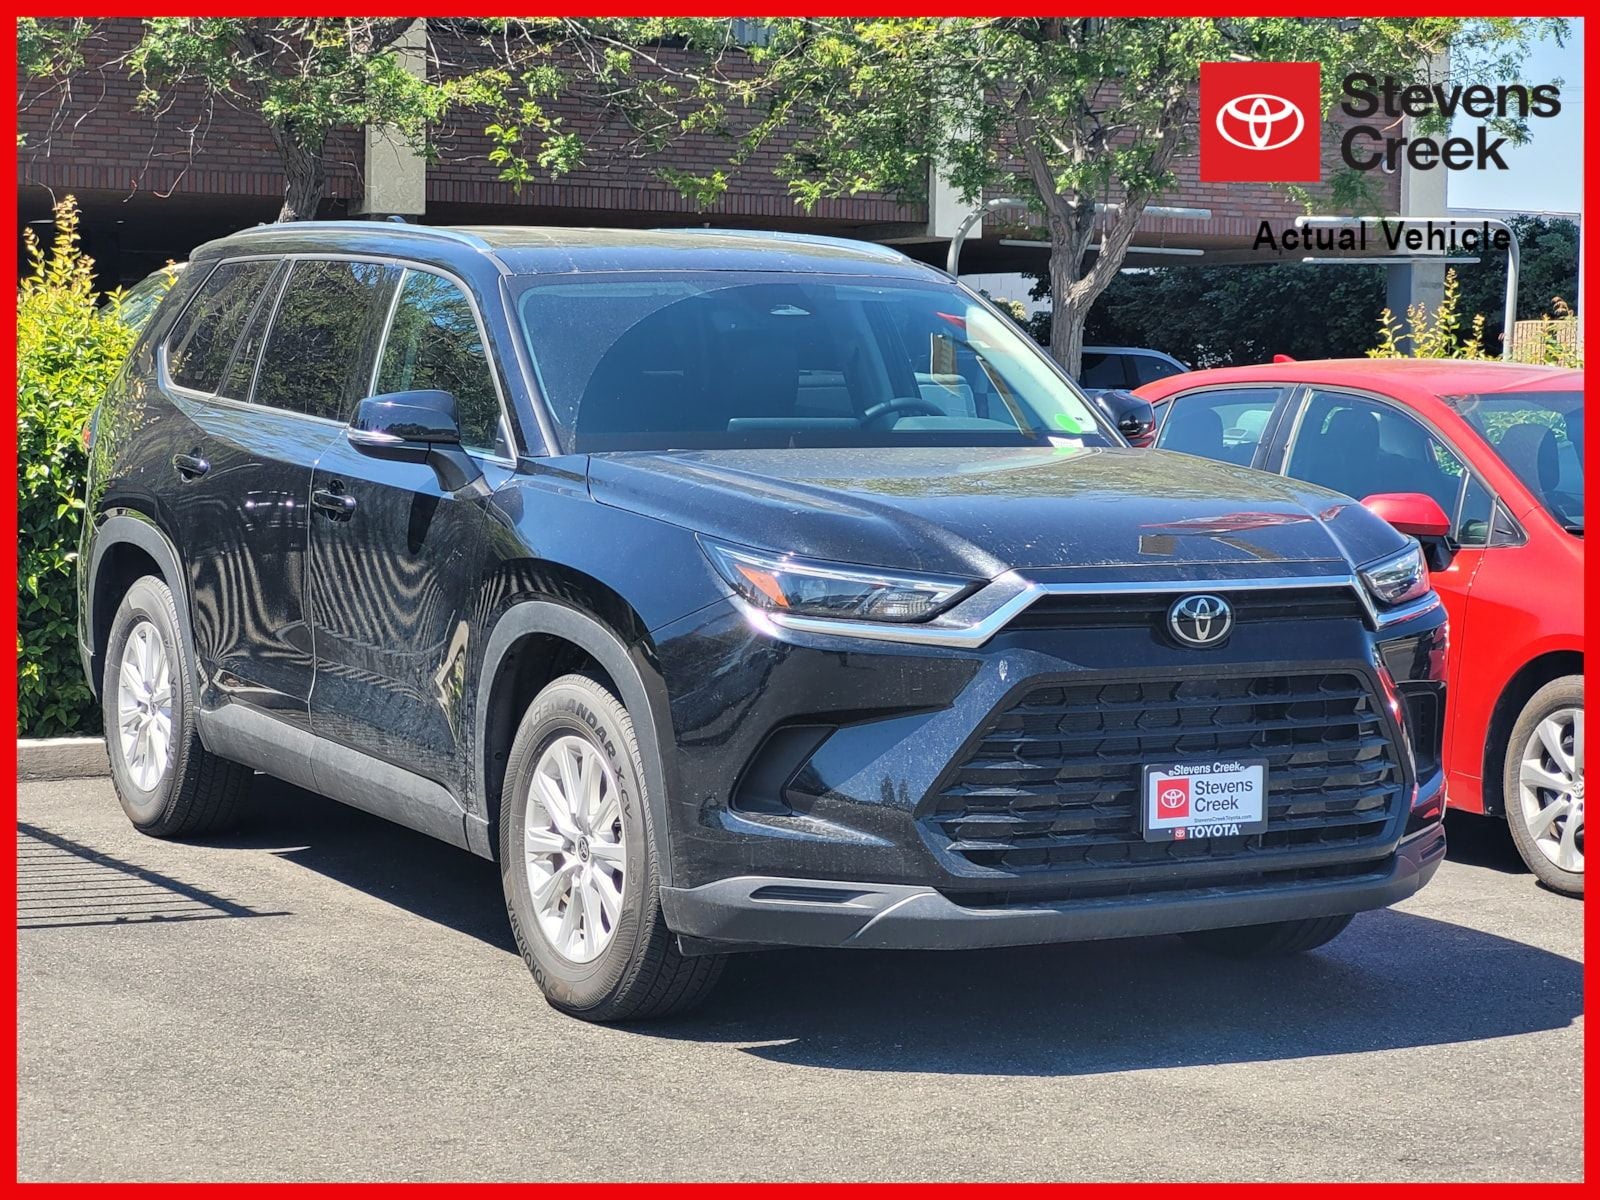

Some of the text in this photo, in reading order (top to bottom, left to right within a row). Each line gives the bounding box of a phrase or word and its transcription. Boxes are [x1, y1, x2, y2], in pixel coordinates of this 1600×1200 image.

[1174, 761, 1241, 776] Stevens Creek
[1194, 780, 1253, 796] Stevens
[1194, 796, 1239, 812] Creek
[1187, 823, 1240, 839] TOYOTA
[507, 898, 547, 992] YOKOHAMA
